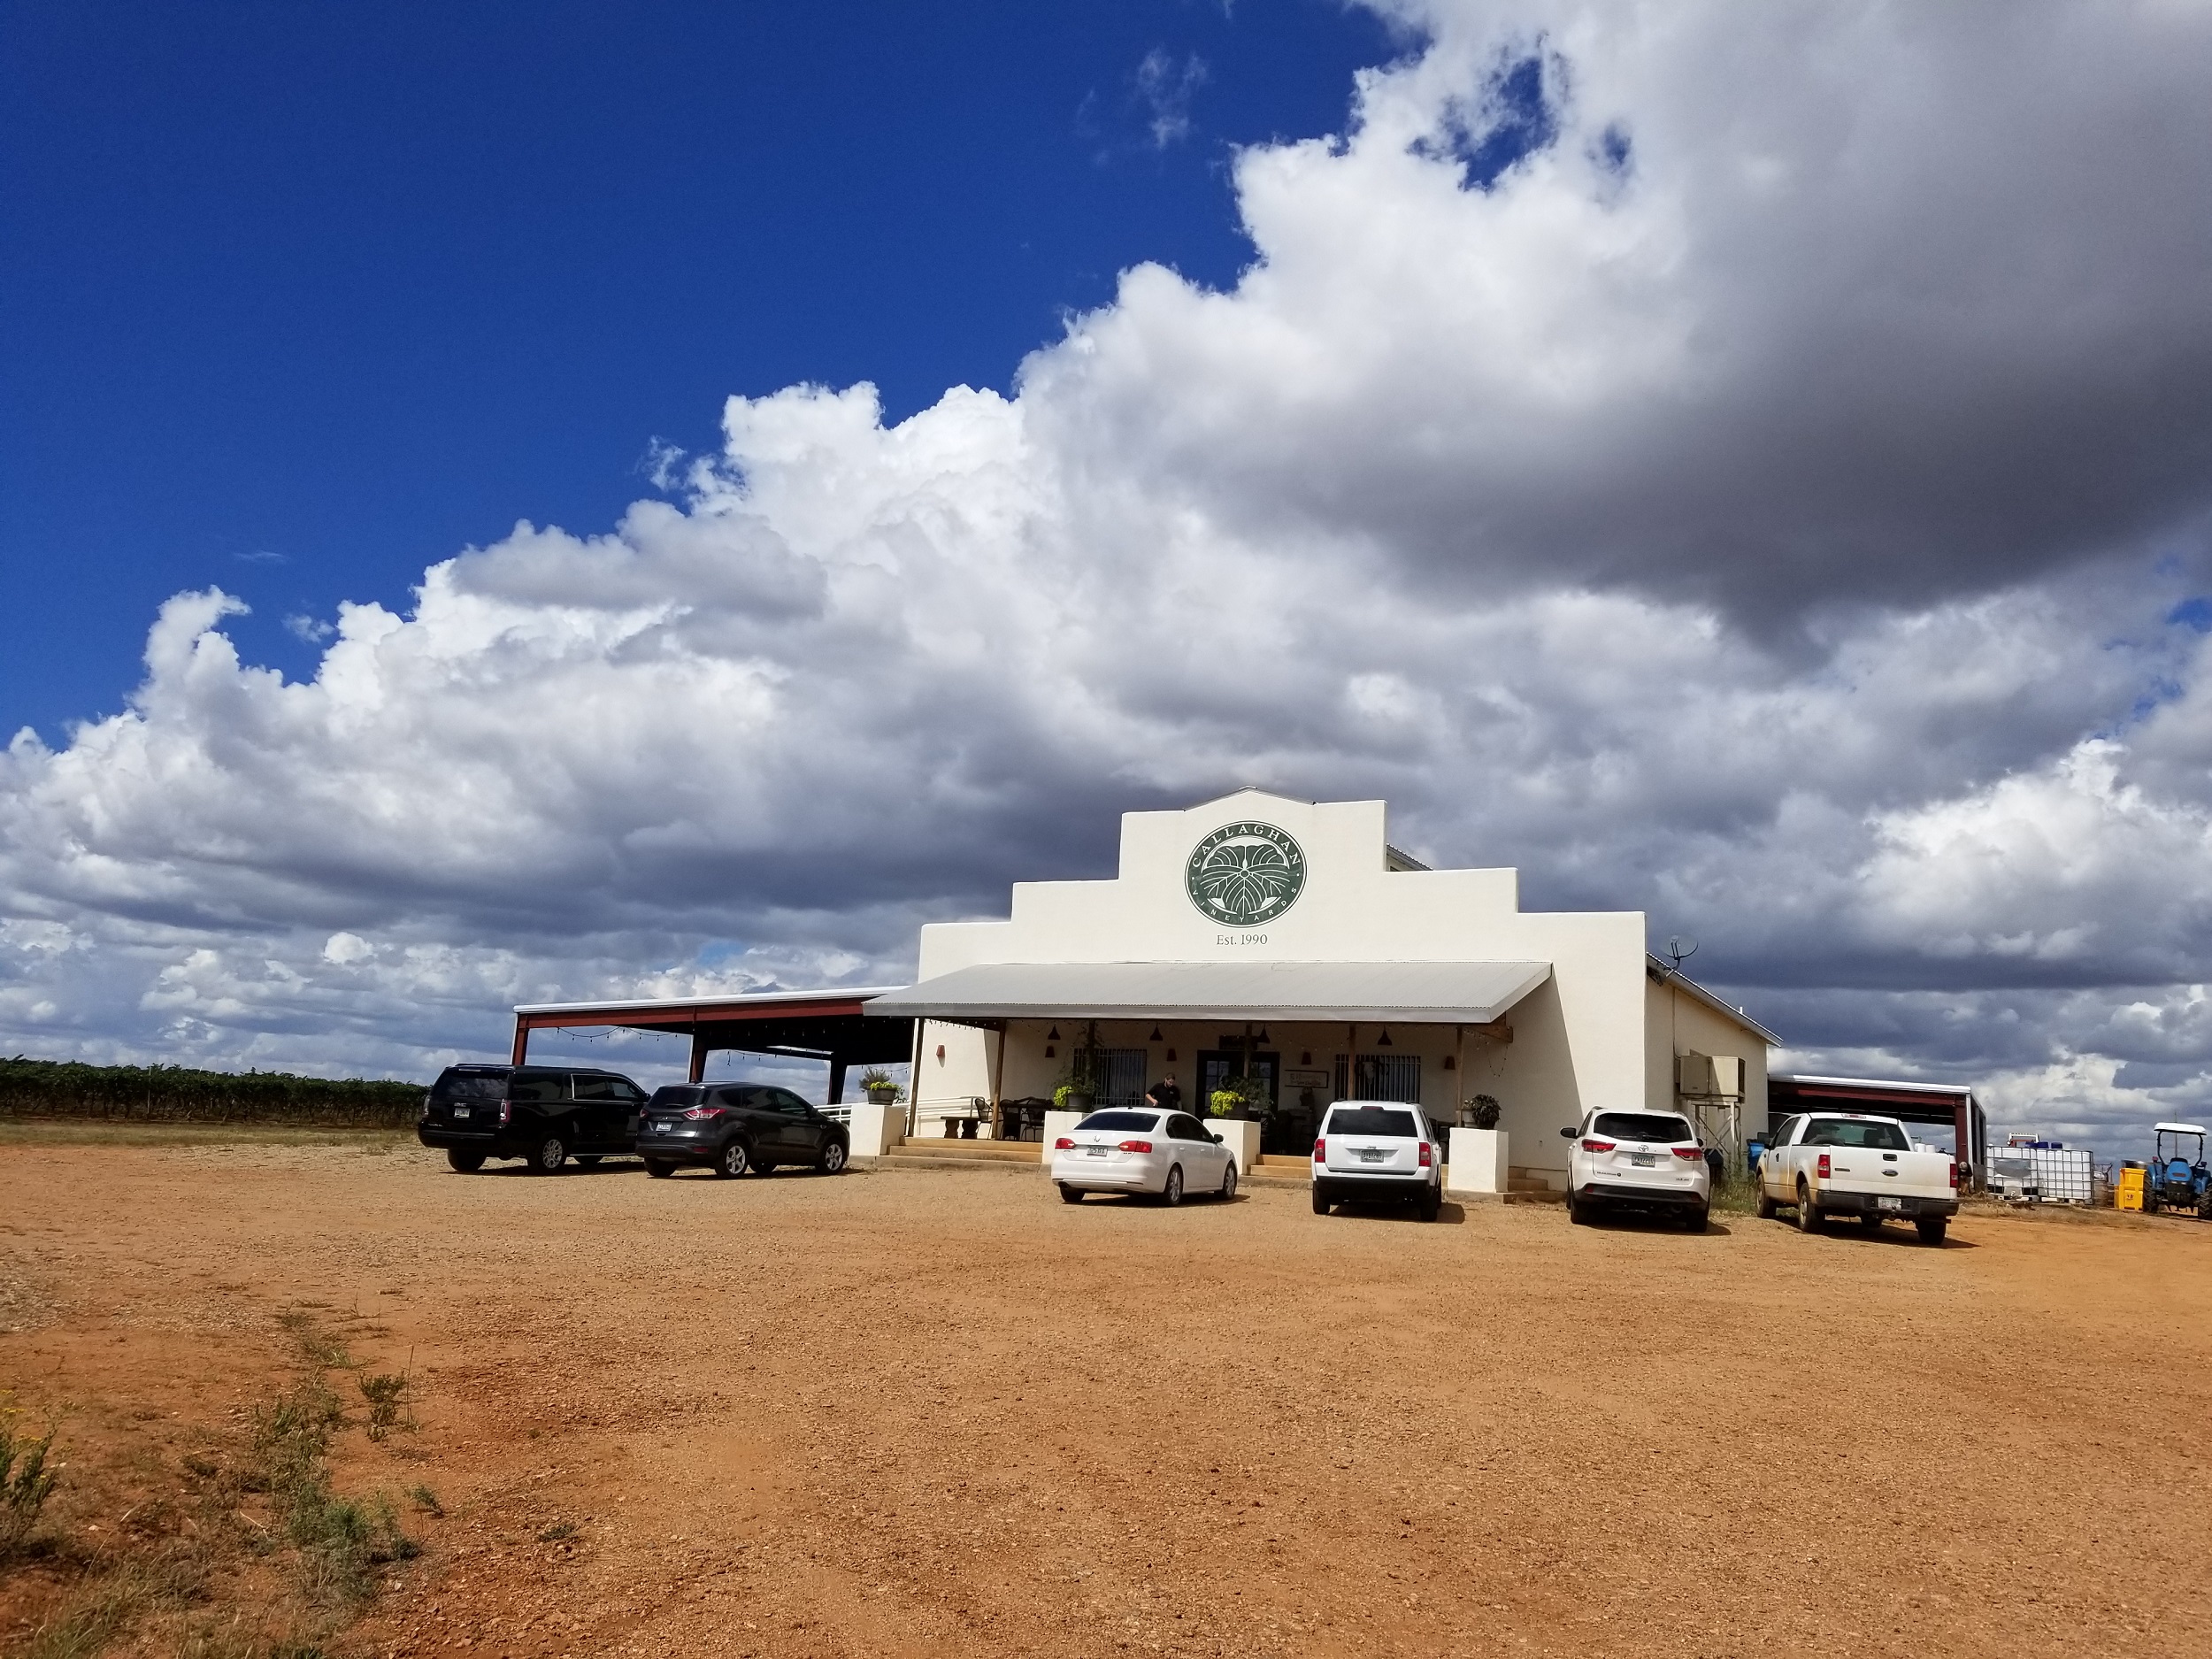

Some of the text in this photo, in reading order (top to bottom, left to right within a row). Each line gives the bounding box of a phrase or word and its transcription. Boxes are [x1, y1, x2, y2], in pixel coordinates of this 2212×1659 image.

[1192, 824, 1301, 868] CALLAGHAN
[1193, 887, 1297, 923] VINEYARDS
[1217, 933, 1268, 946] Est. 1990
